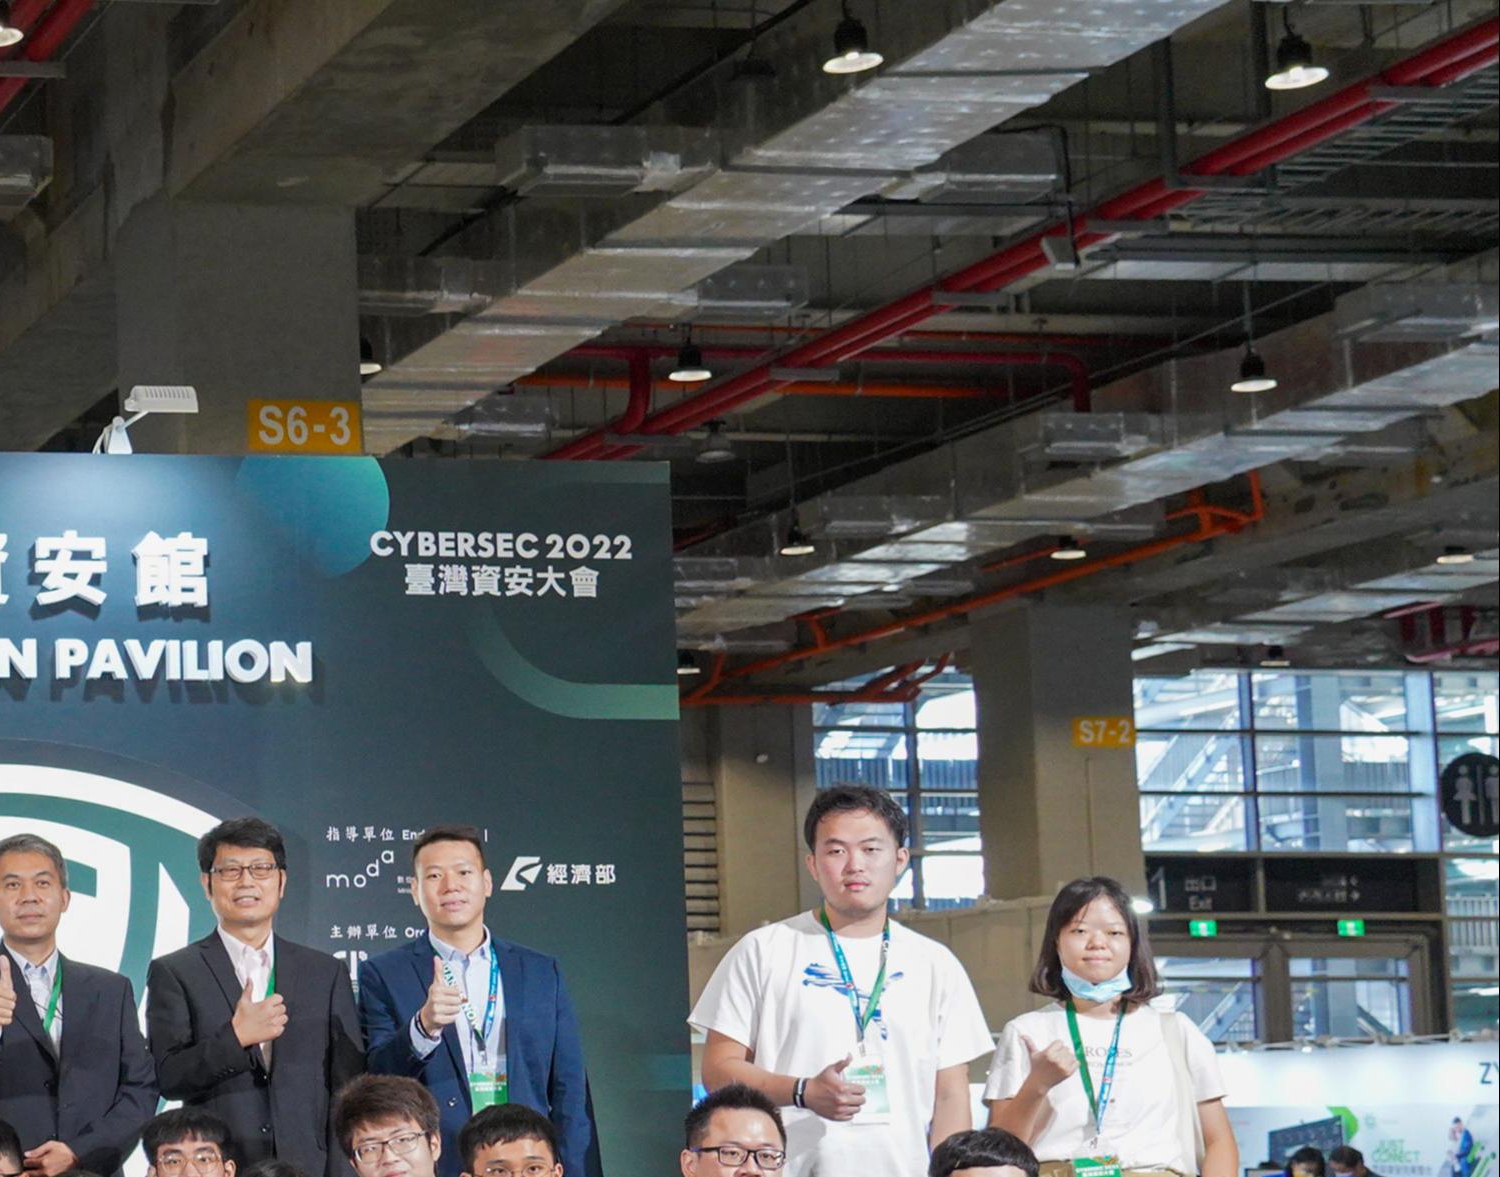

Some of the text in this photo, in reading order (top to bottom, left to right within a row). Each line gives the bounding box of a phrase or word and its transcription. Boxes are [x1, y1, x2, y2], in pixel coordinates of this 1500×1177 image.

[259, 405, 351, 446] S6-3
[370, 530, 633, 560] CYBERSEC 2022
[404, 563, 601, 598] 臺灣資安大會
[55, 638, 314, 683] PAVILION
[1080, 719, 1131, 744] S7-2
[326, 826, 395, 842] 指導單位
[326, 850, 395, 888] moda
[546, 863, 616, 885] 經濟部
[330, 925, 398, 940] 主辦單位
